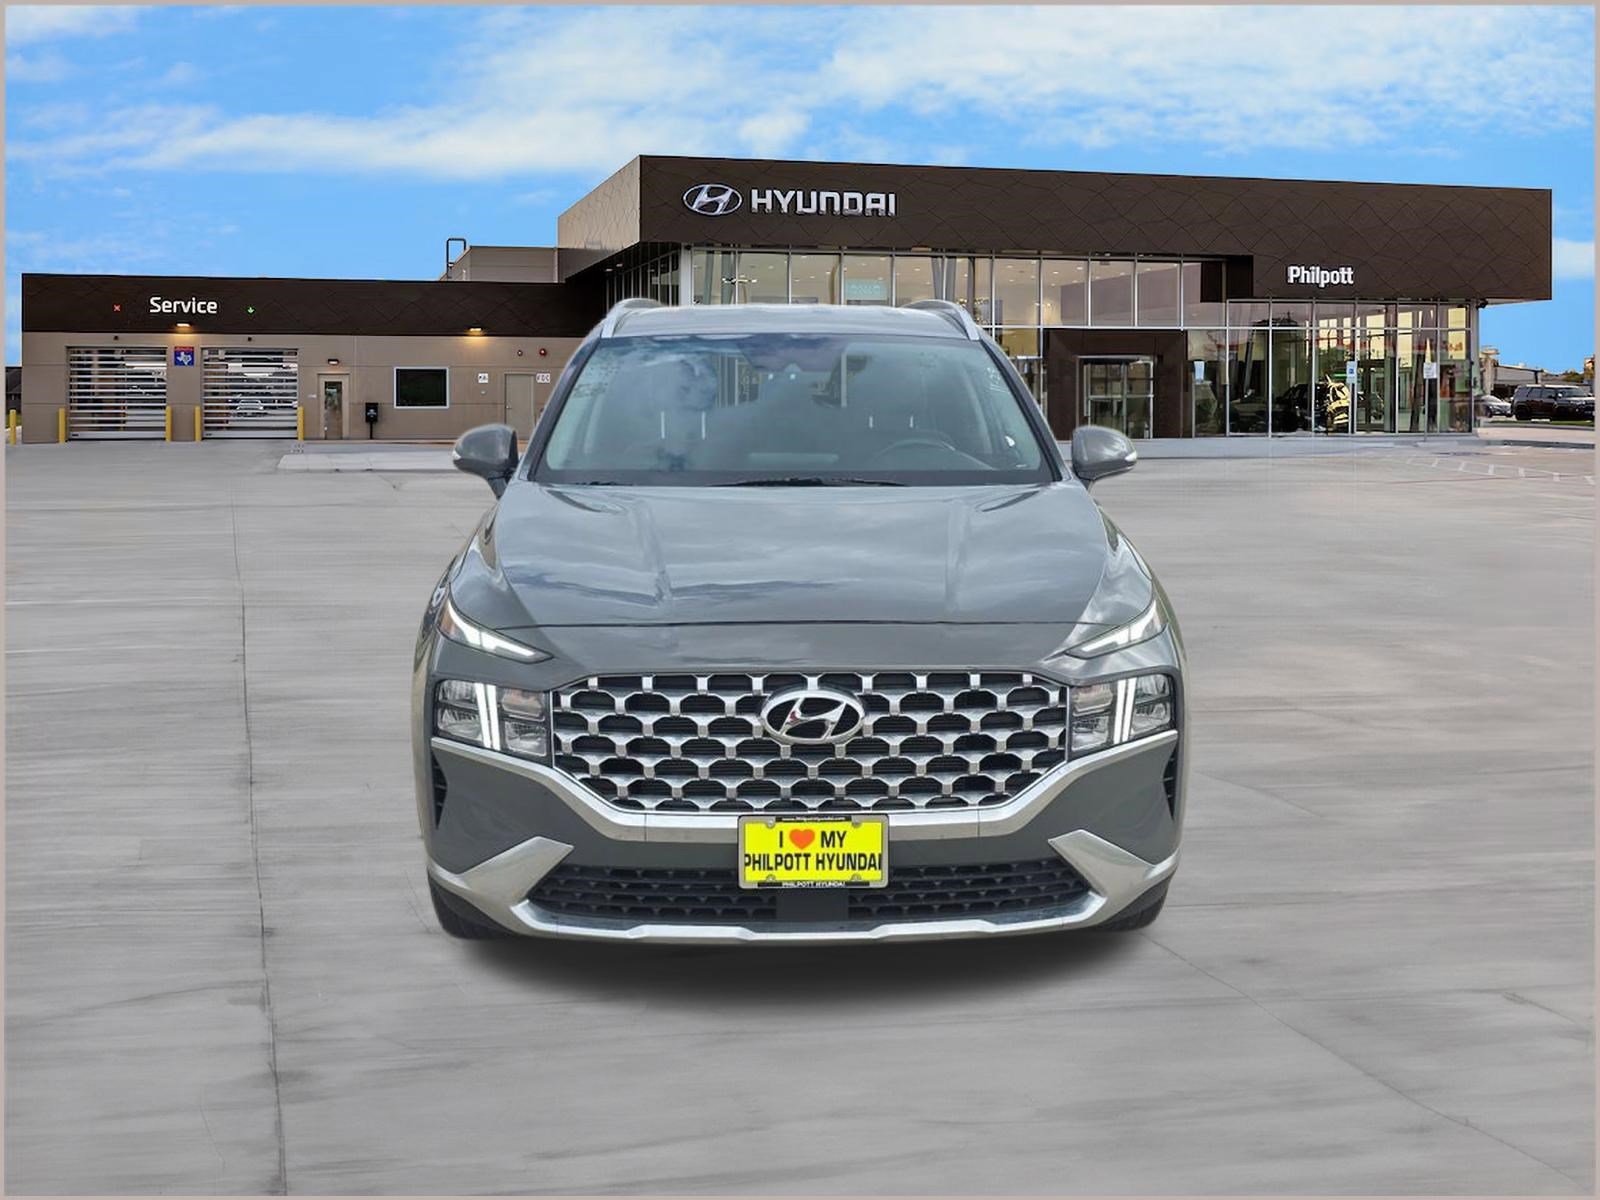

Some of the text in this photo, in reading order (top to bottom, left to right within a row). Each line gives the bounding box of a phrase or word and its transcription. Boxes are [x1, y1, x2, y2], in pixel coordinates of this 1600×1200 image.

[751, 189, 896, 216] HYUNDAI
[1287, 265, 1354, 288] Philpott
[149, 296, 218, 314] Service
[779, 830, 847, 848] I MY
[744, 853, 882, 871] PHILPOTT HYUNDAI
